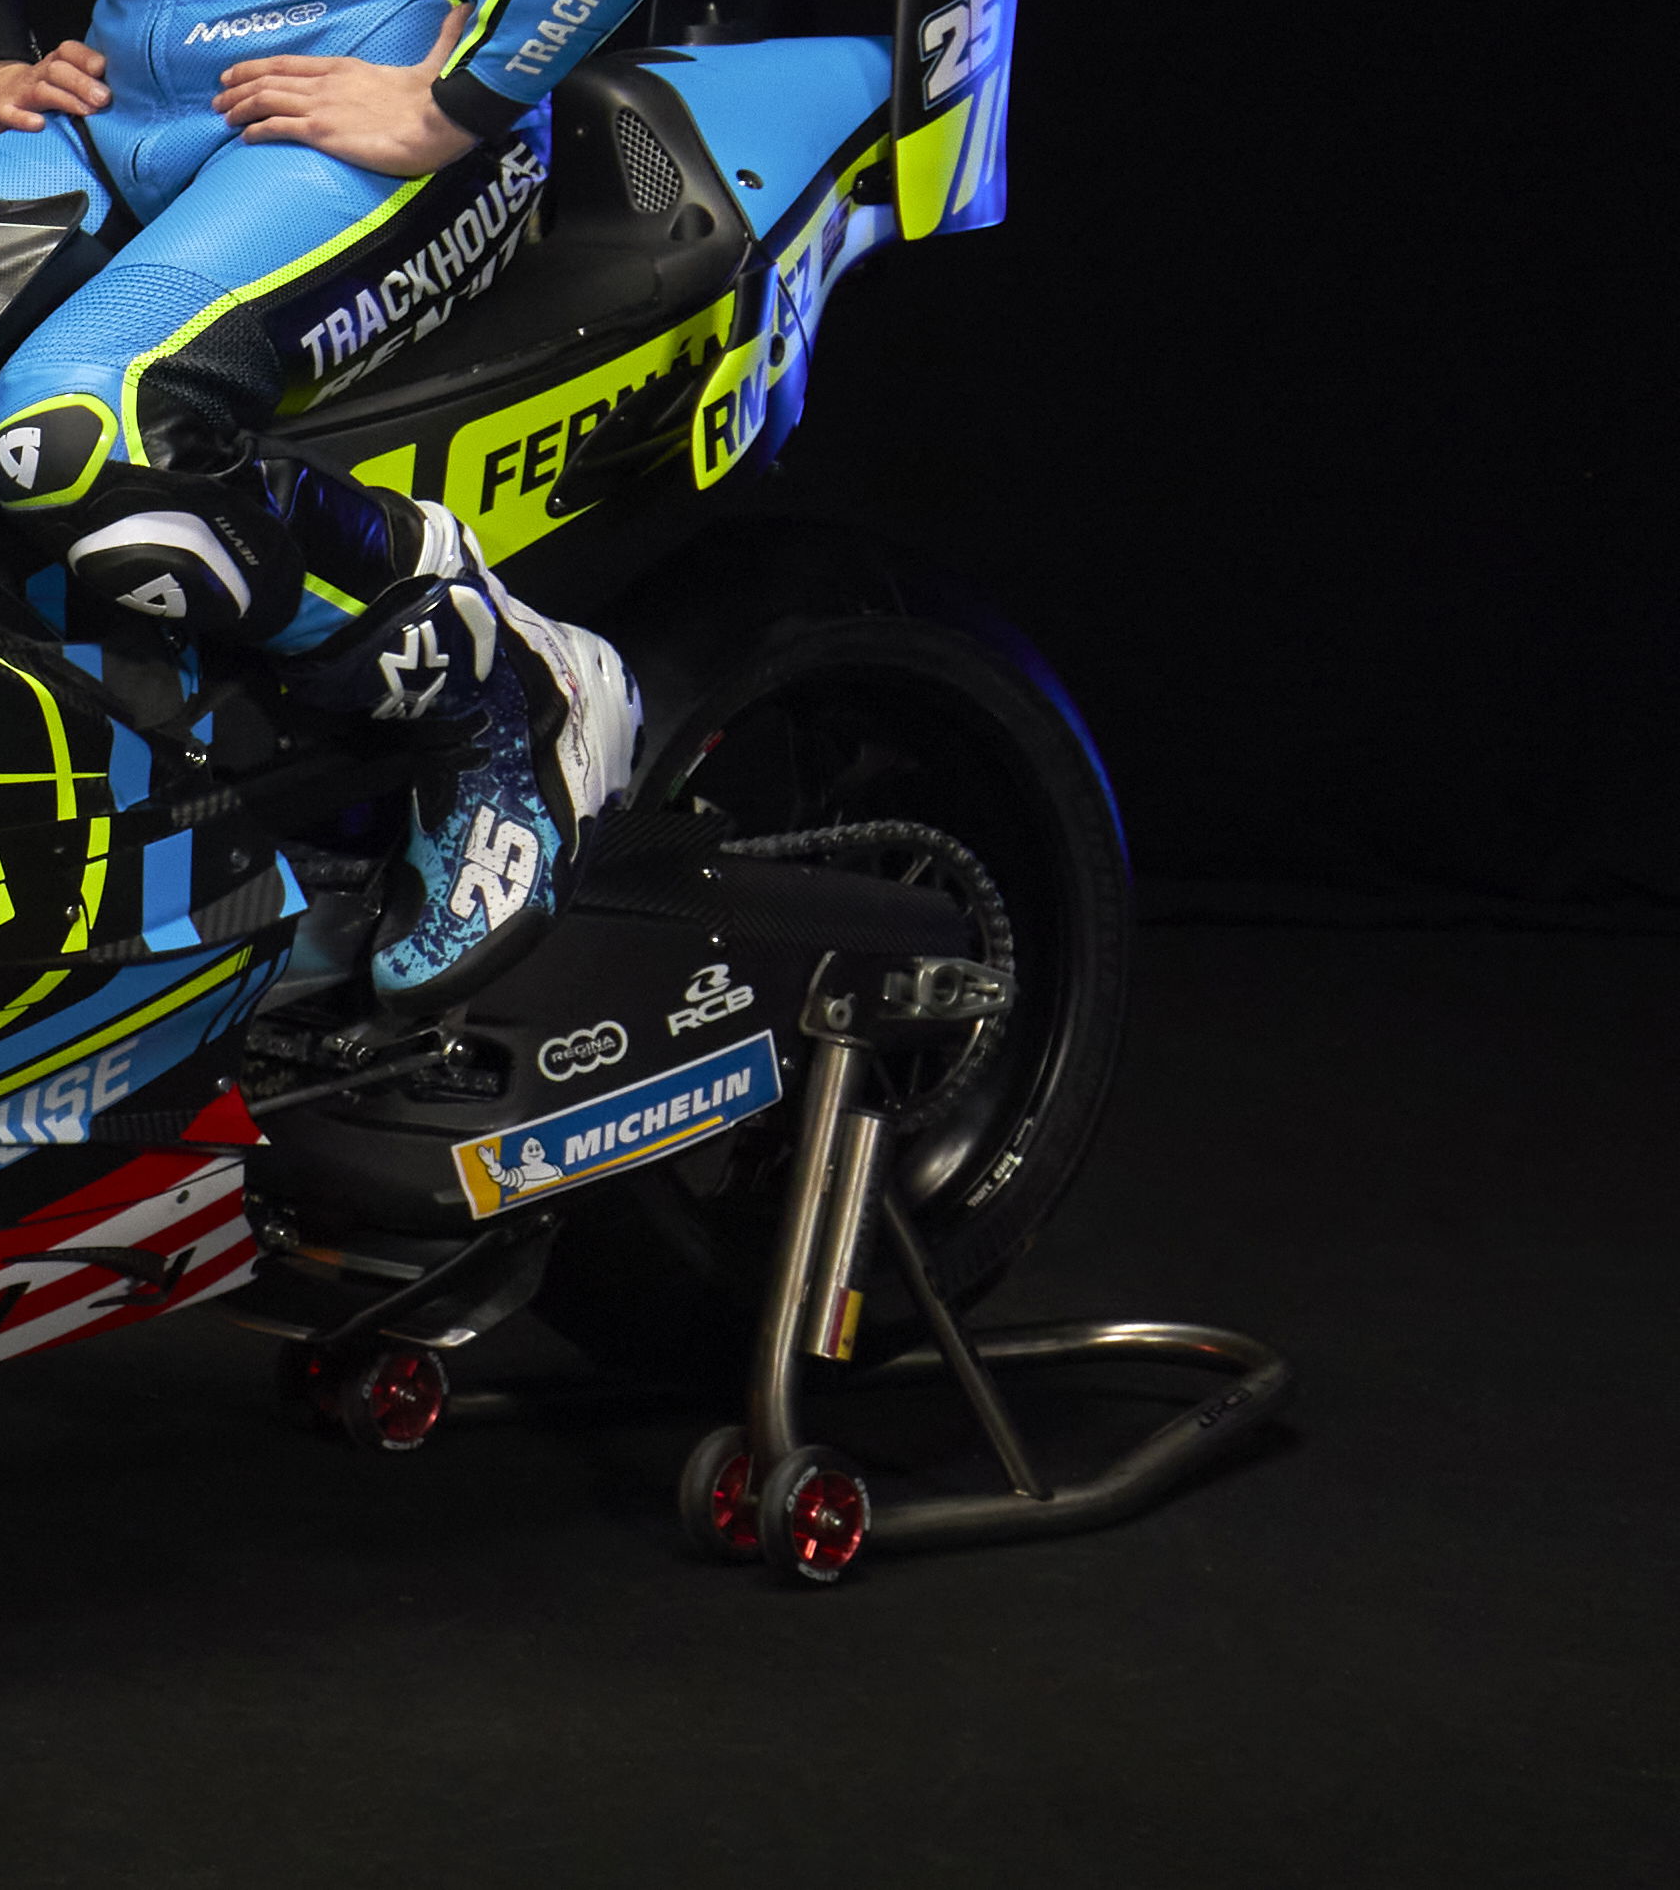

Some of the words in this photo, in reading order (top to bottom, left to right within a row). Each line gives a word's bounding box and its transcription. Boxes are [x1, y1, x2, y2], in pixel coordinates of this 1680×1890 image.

[300, 142, 547, 380] TRACKHOUSE
[449, 804, 540, 931] 25
[551, 1033, 617, 1063] REGINA
[665, 984, 755, 1039] RCB
[564, 1066, 752, 1167] MICHELIN
